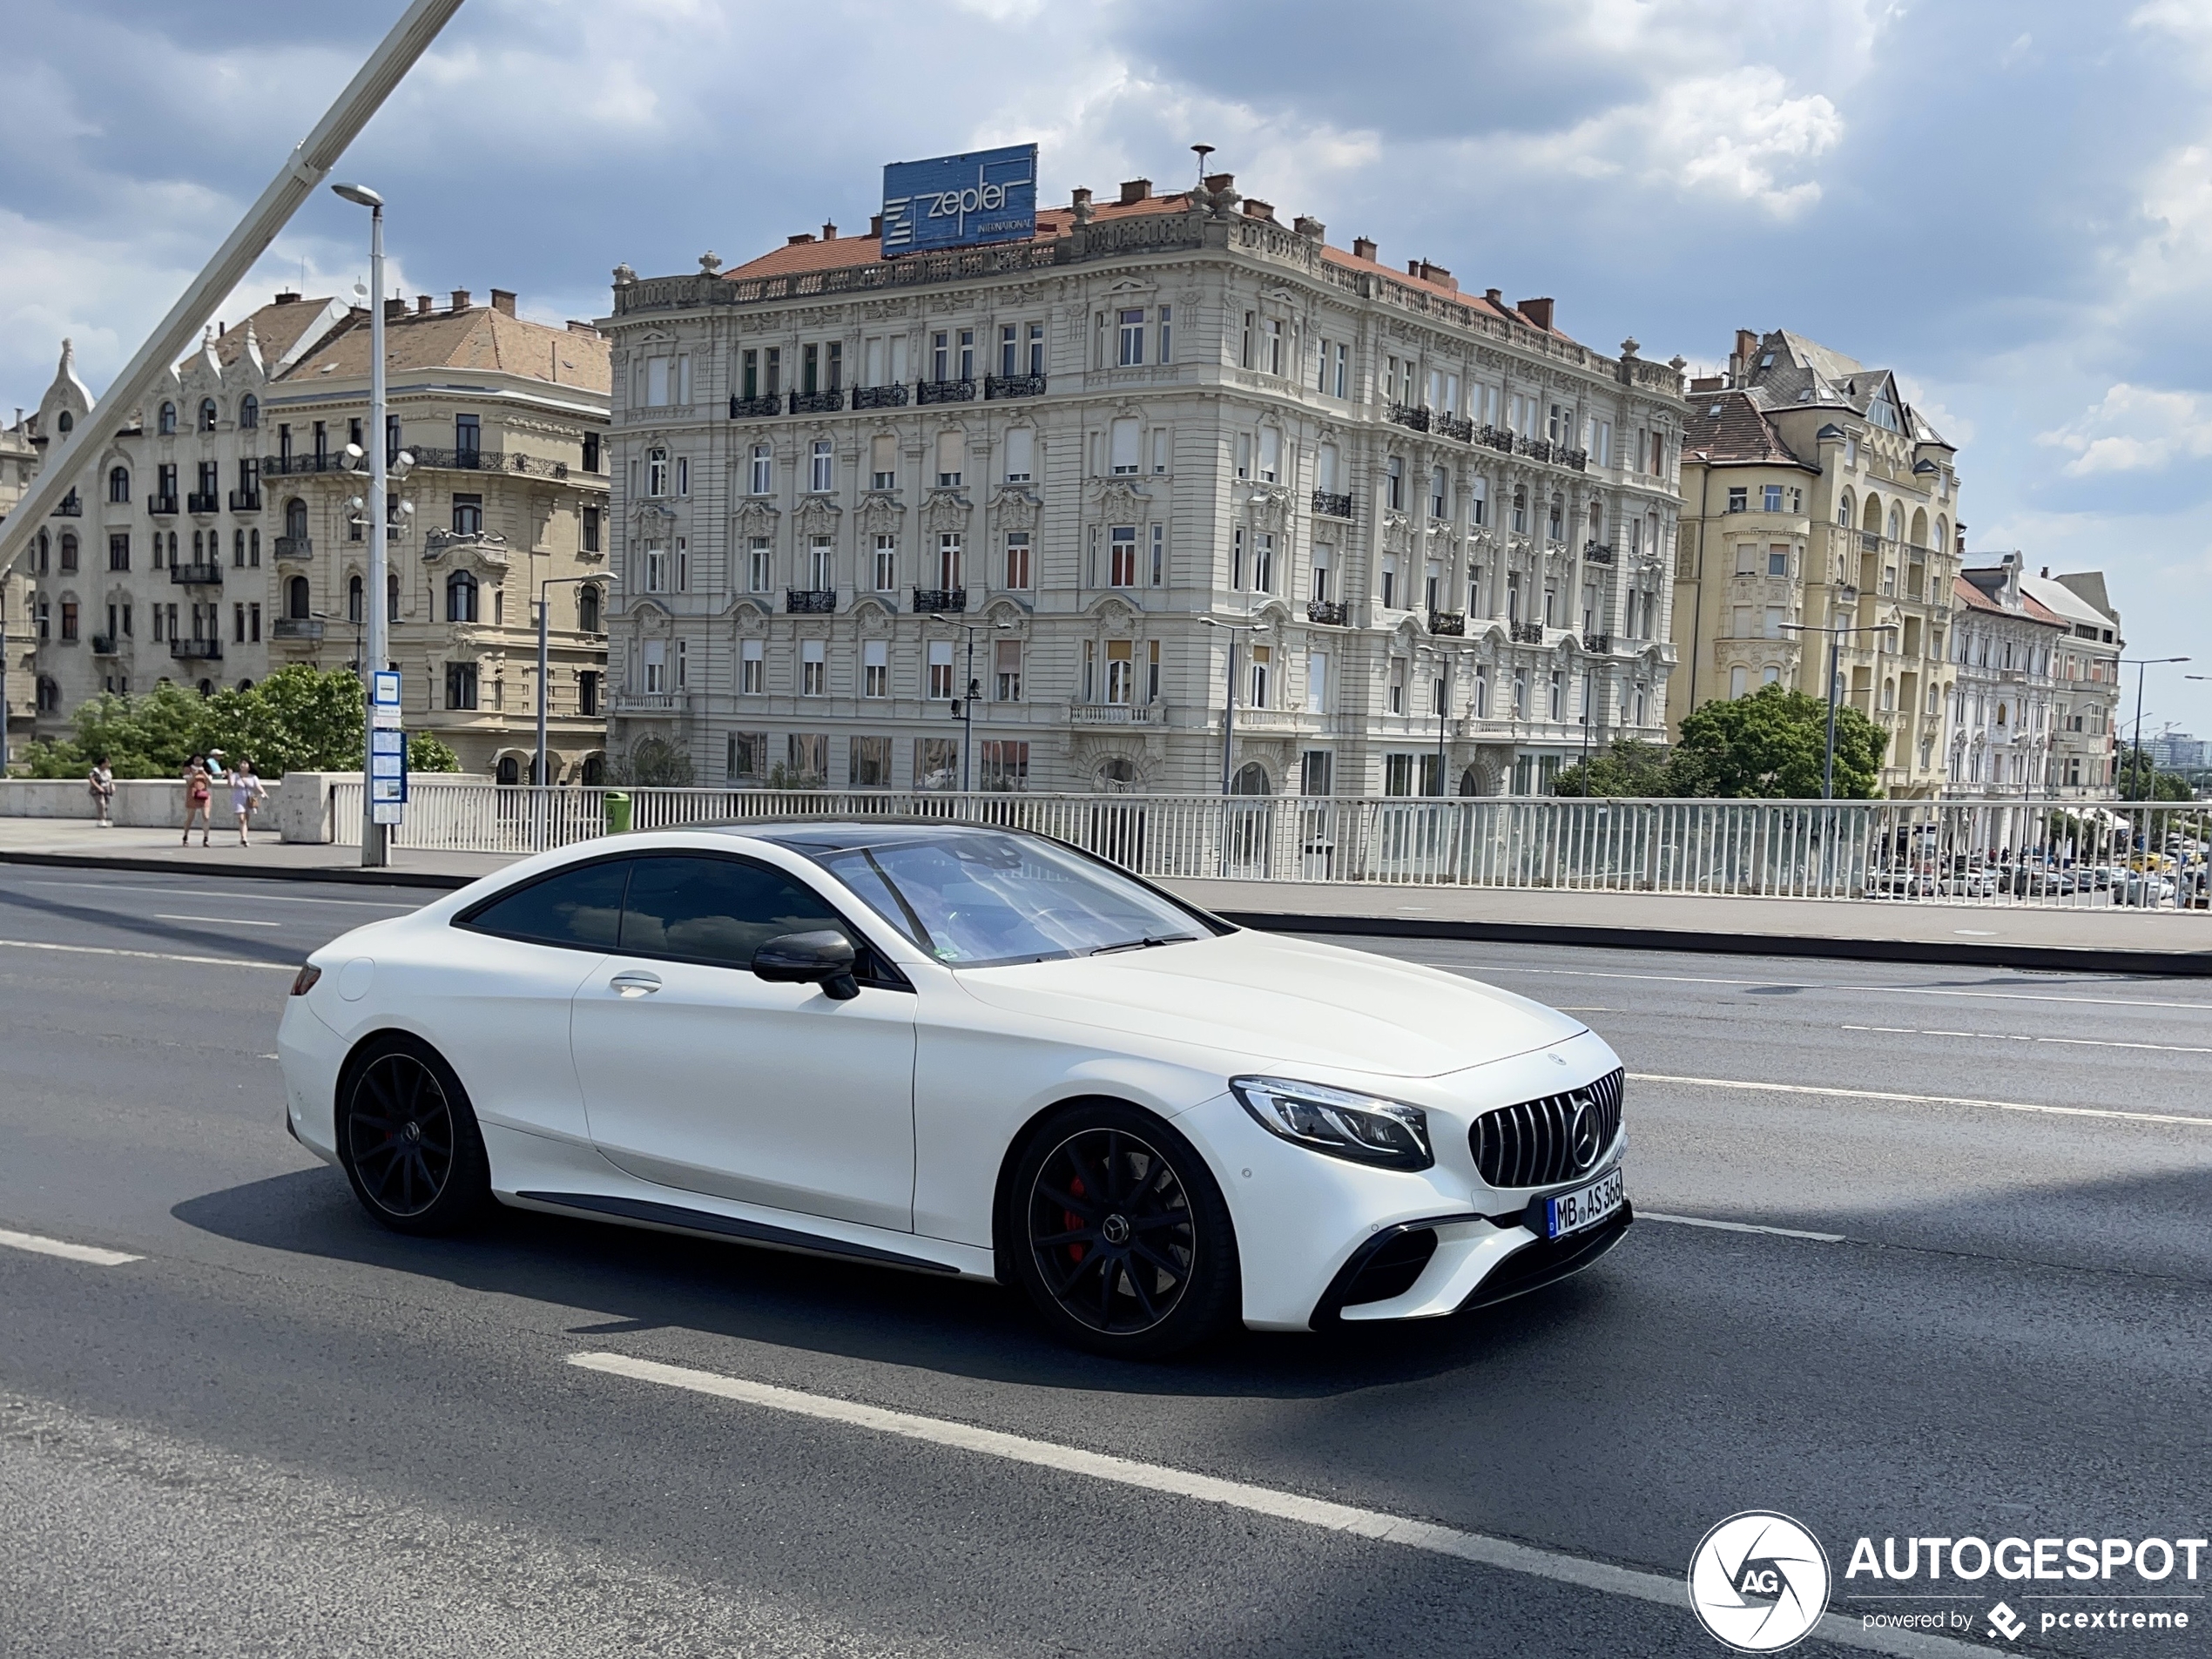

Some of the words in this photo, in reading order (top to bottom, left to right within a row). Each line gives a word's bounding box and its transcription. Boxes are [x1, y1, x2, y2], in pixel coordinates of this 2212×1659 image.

[977, 219, 1032, 233] INTERNATIONAL
[1557, 1197, 1577, 1231] MB
[1587, 1185, 1602, 1218] AS
[1603, 1174, 1621, 1209] 366
